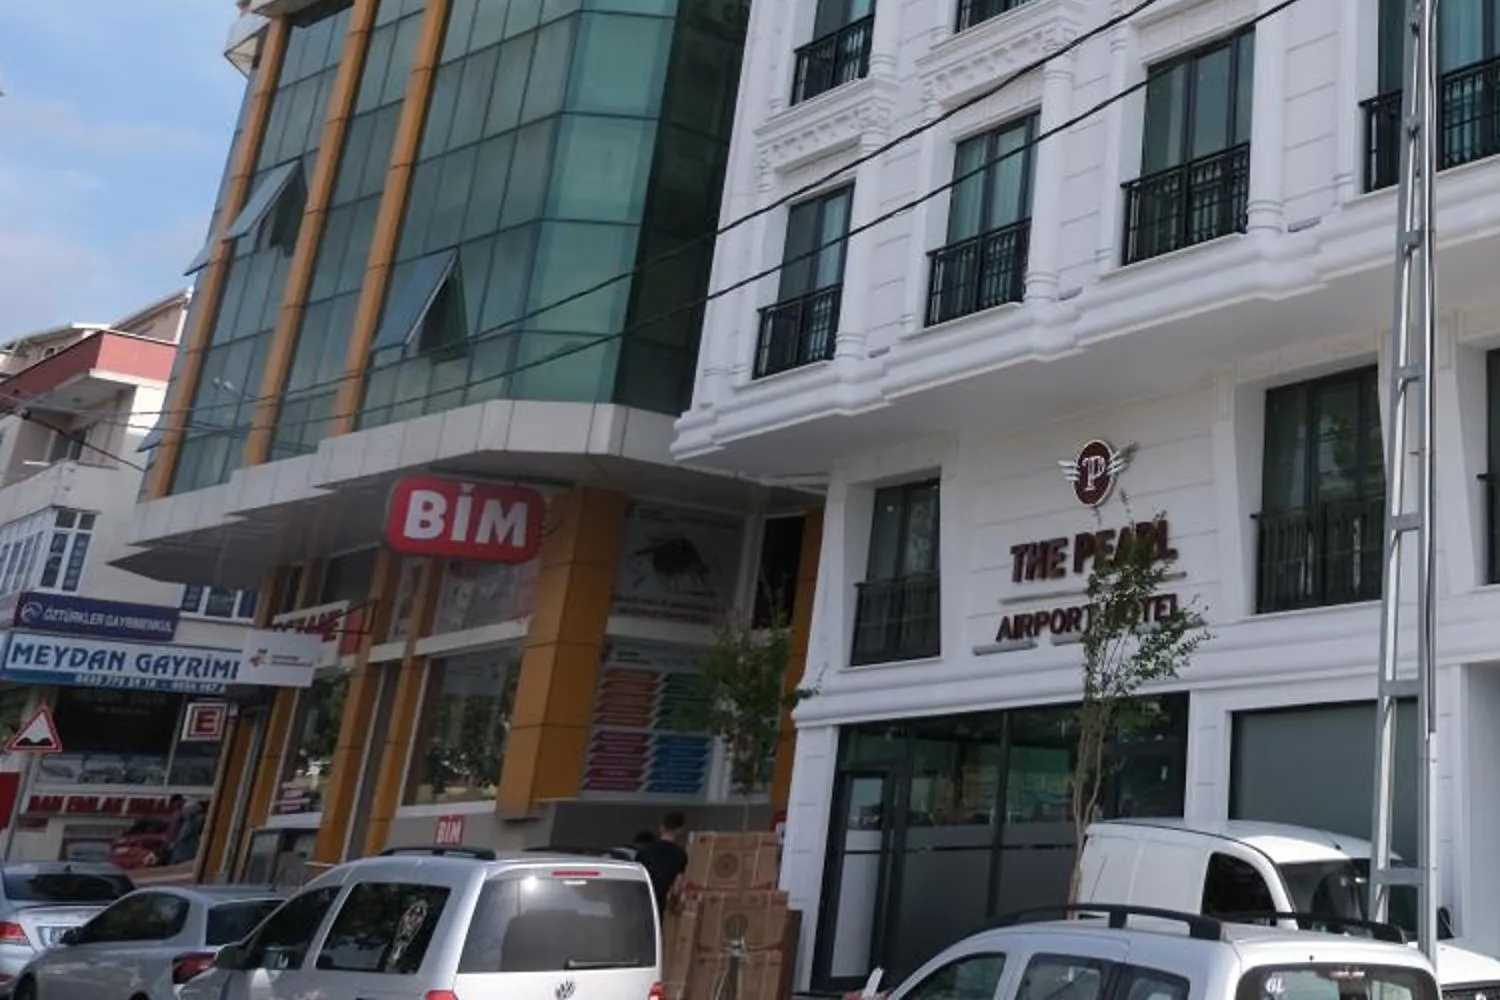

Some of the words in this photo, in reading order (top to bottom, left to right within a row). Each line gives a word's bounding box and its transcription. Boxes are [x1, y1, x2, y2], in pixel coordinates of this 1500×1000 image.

[403, 482, 528, 548] BİM
[1010, 536, 1069, 583] THE
[11, 641, 127, 673] MEYDAN
